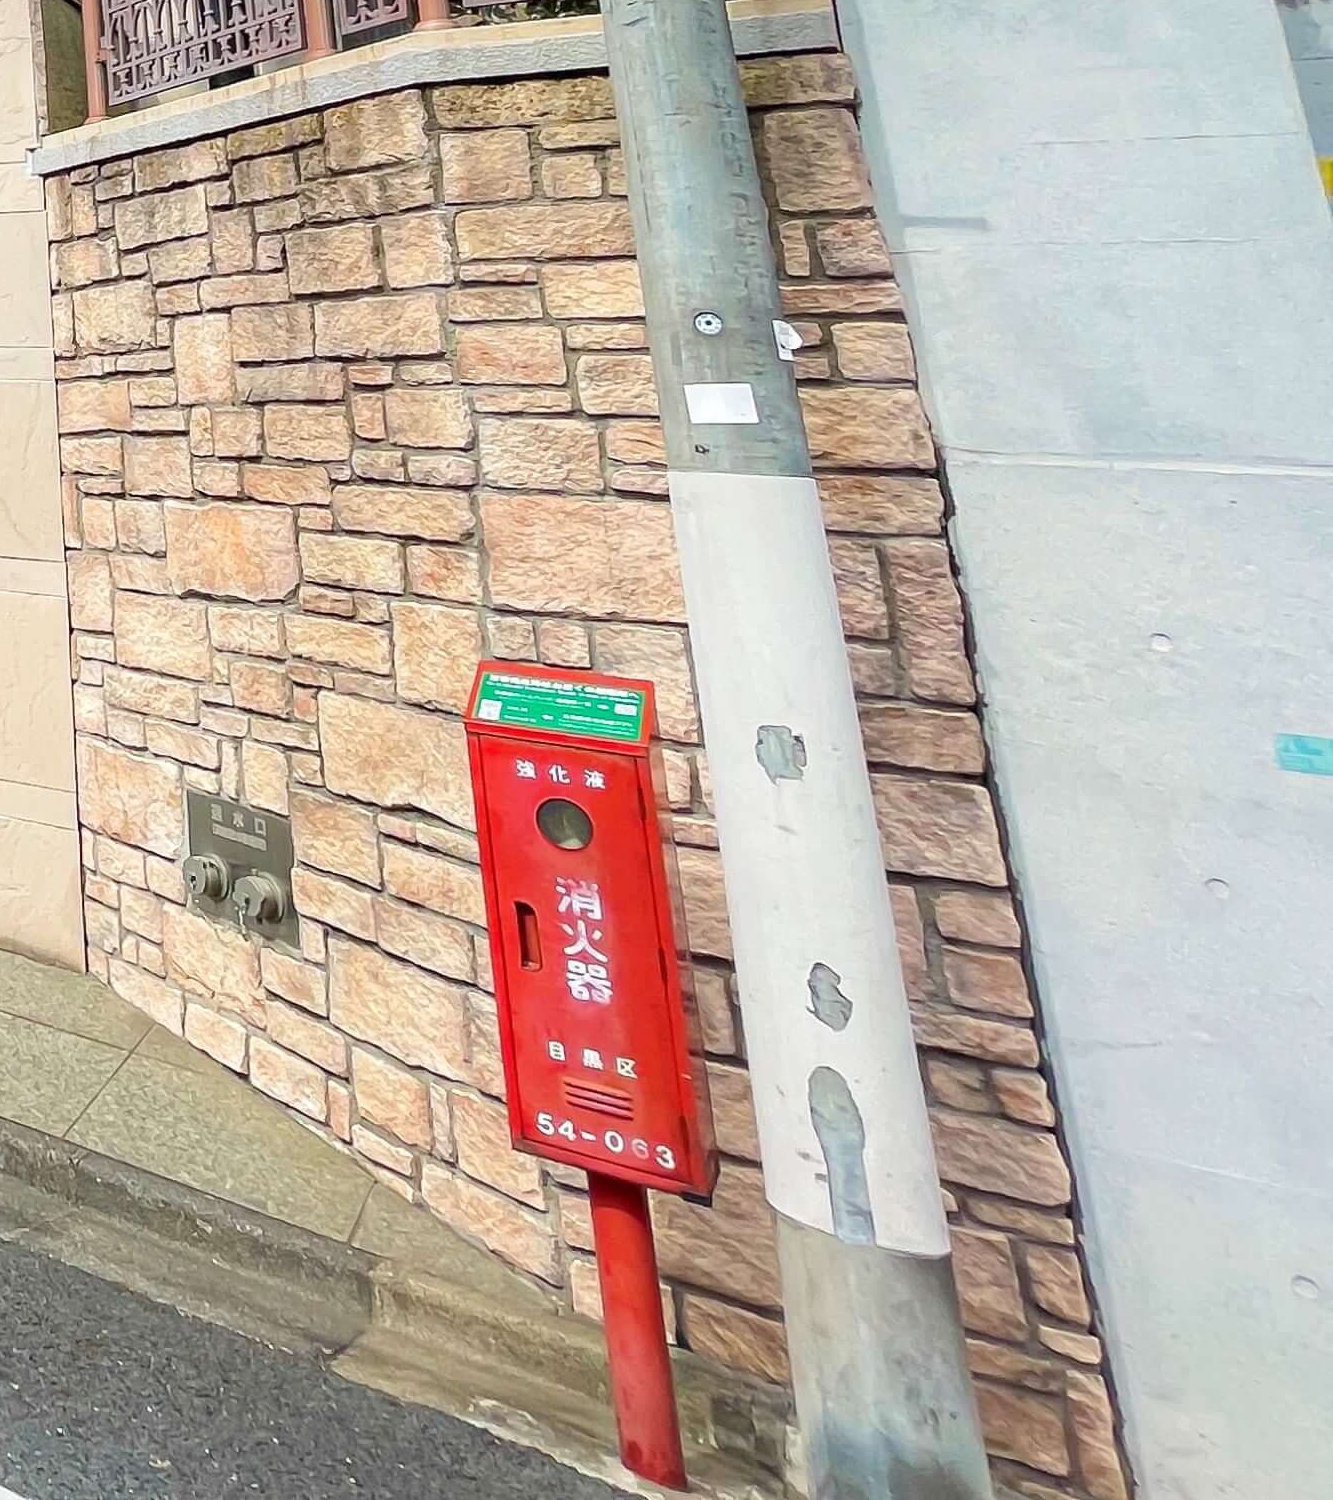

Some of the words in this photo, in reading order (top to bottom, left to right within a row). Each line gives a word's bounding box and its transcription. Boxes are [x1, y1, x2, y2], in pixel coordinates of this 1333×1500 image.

[516, 759, 605, 789] 強化液
[556, 877, 613, 1004] 消火器
[548, 1041, 637, 1078] 目黒区
[536, 1112, 676, 1170] 54-063
